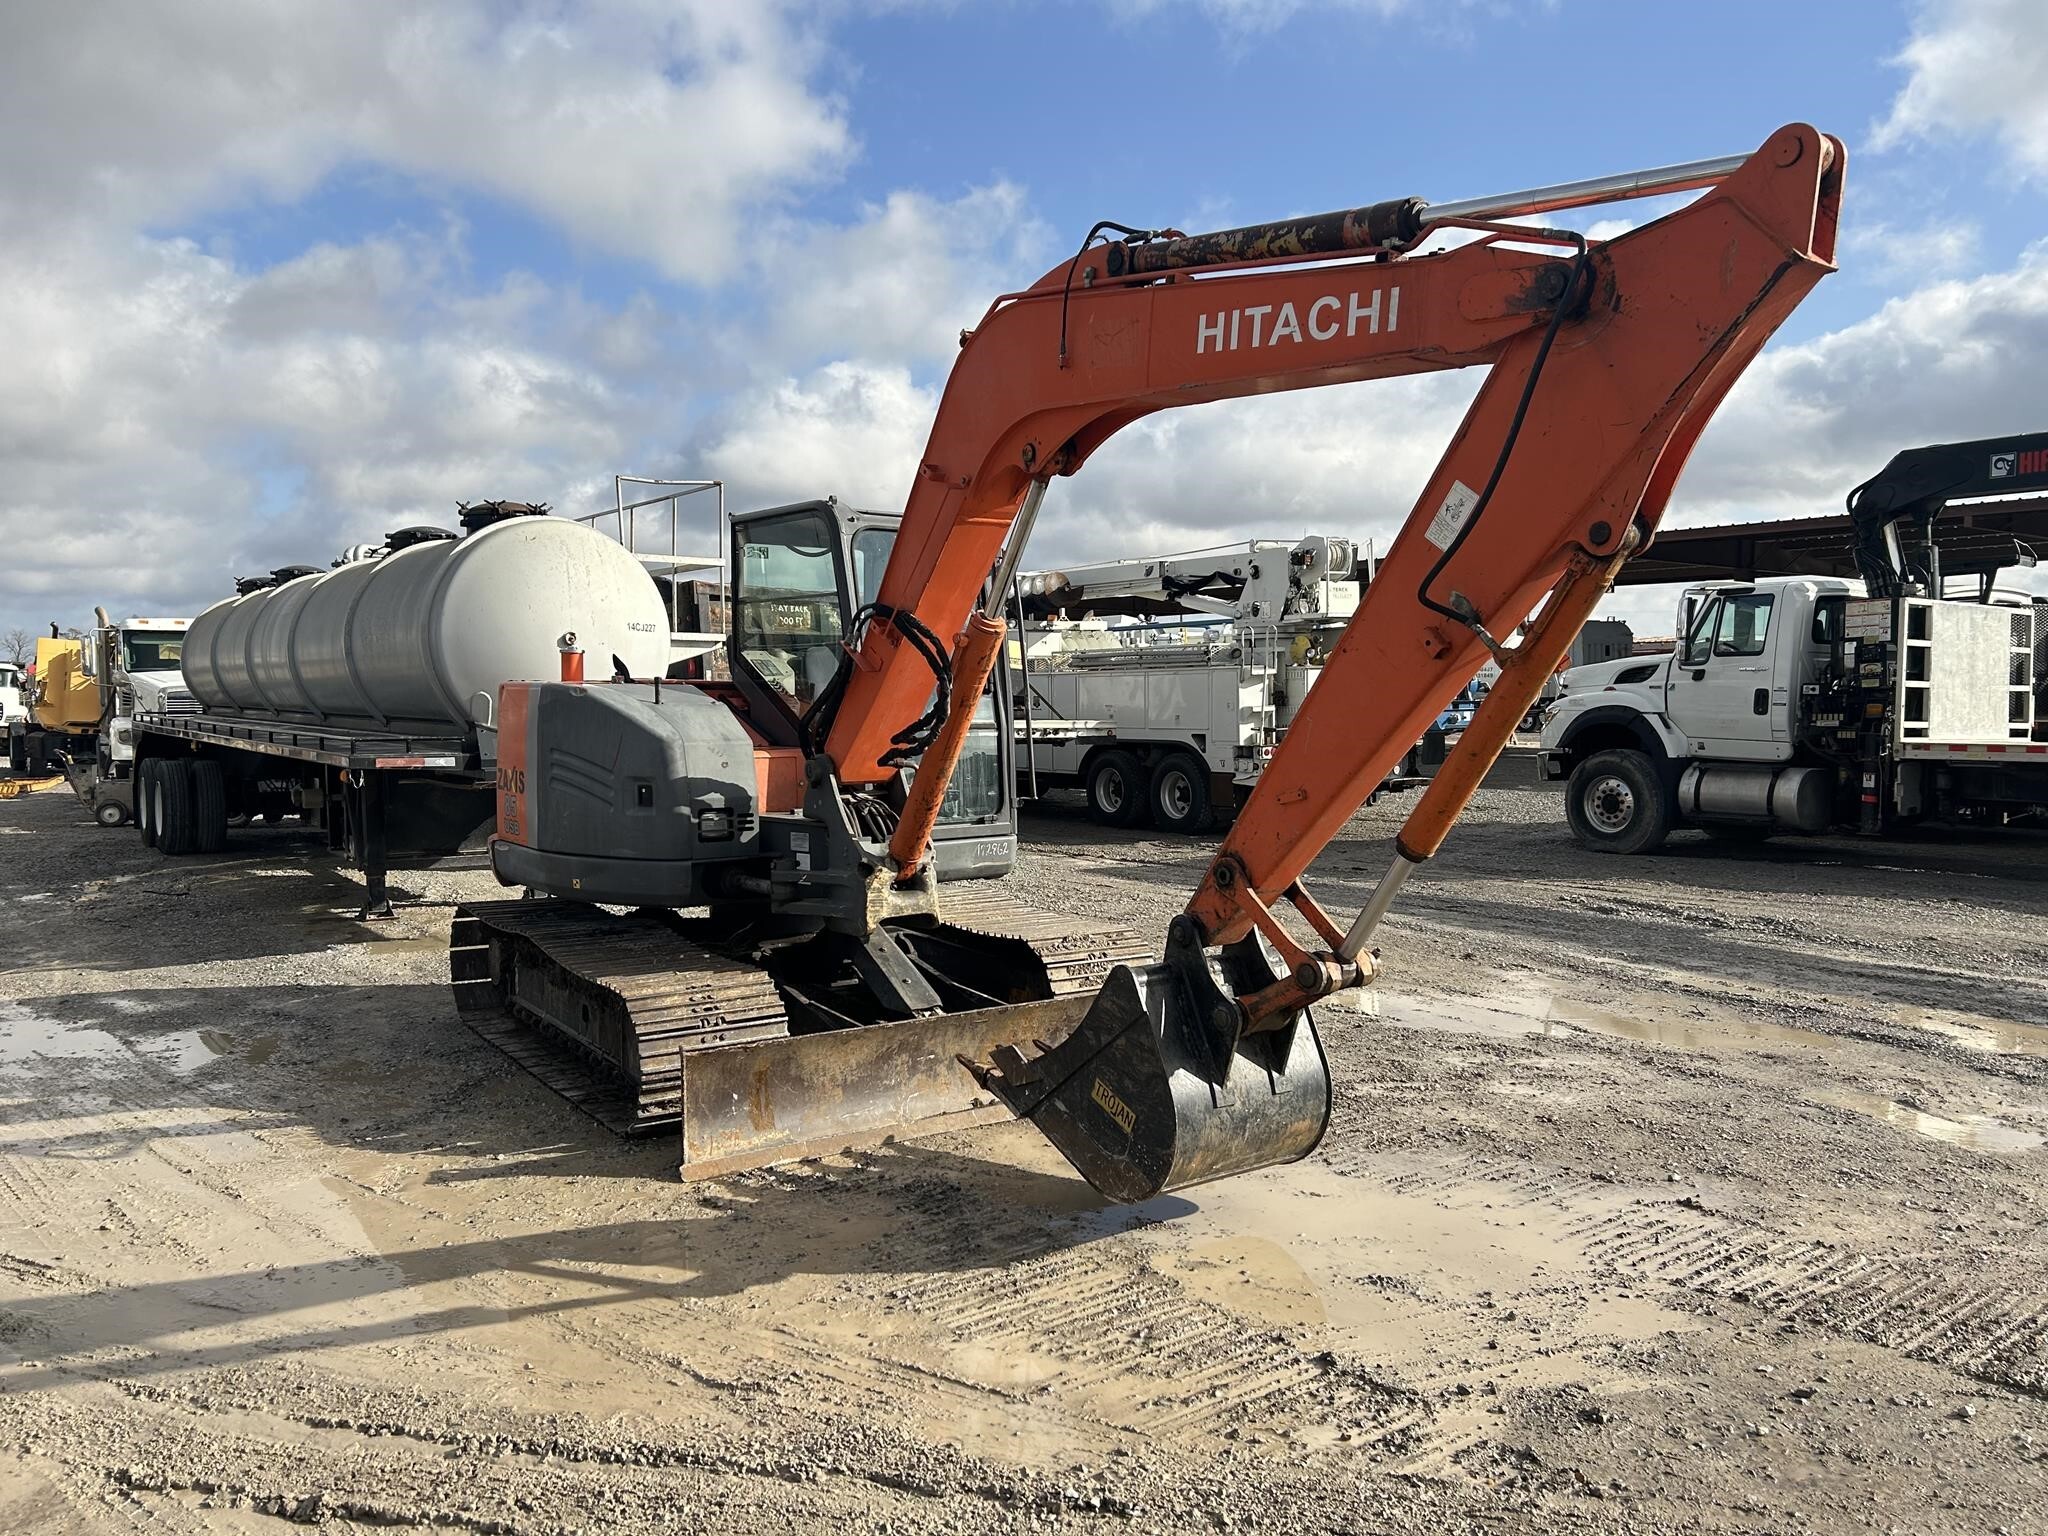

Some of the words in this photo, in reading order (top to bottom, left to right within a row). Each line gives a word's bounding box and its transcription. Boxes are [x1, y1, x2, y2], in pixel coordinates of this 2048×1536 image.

[1196, 286, 1400, 354] HITACHI
[627, 621, 656, 632] 14CJ227
[497, 766, 525, 794] ZAXIS
[1096, 1081, 1135, 1129] TROJAN
